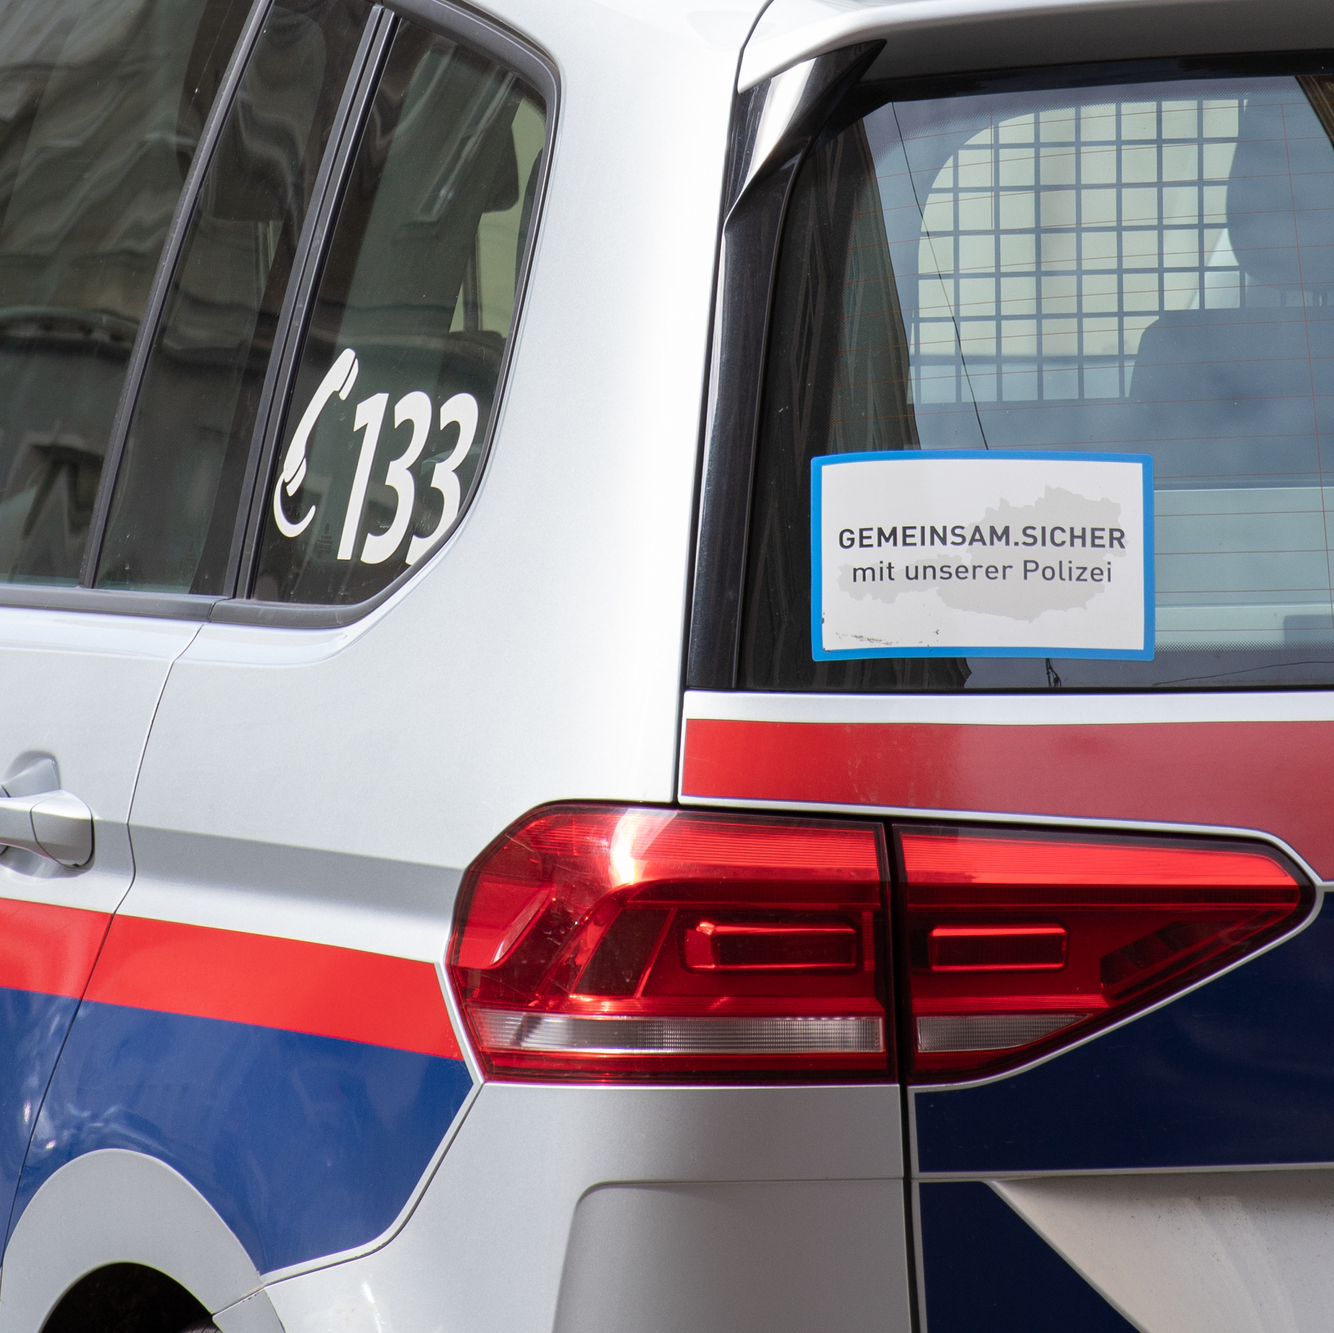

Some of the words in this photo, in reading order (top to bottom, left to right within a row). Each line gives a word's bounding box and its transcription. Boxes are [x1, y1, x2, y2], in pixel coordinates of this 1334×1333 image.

[336, 390, 479, 567] 133
[838, 524, 1127, 550] GEMEINSAM.SICHER
[852, 560, 895, 583] mit
[904, 562, 1014, 582] unserer
[1022, 559, 1113, 584] Polizei
